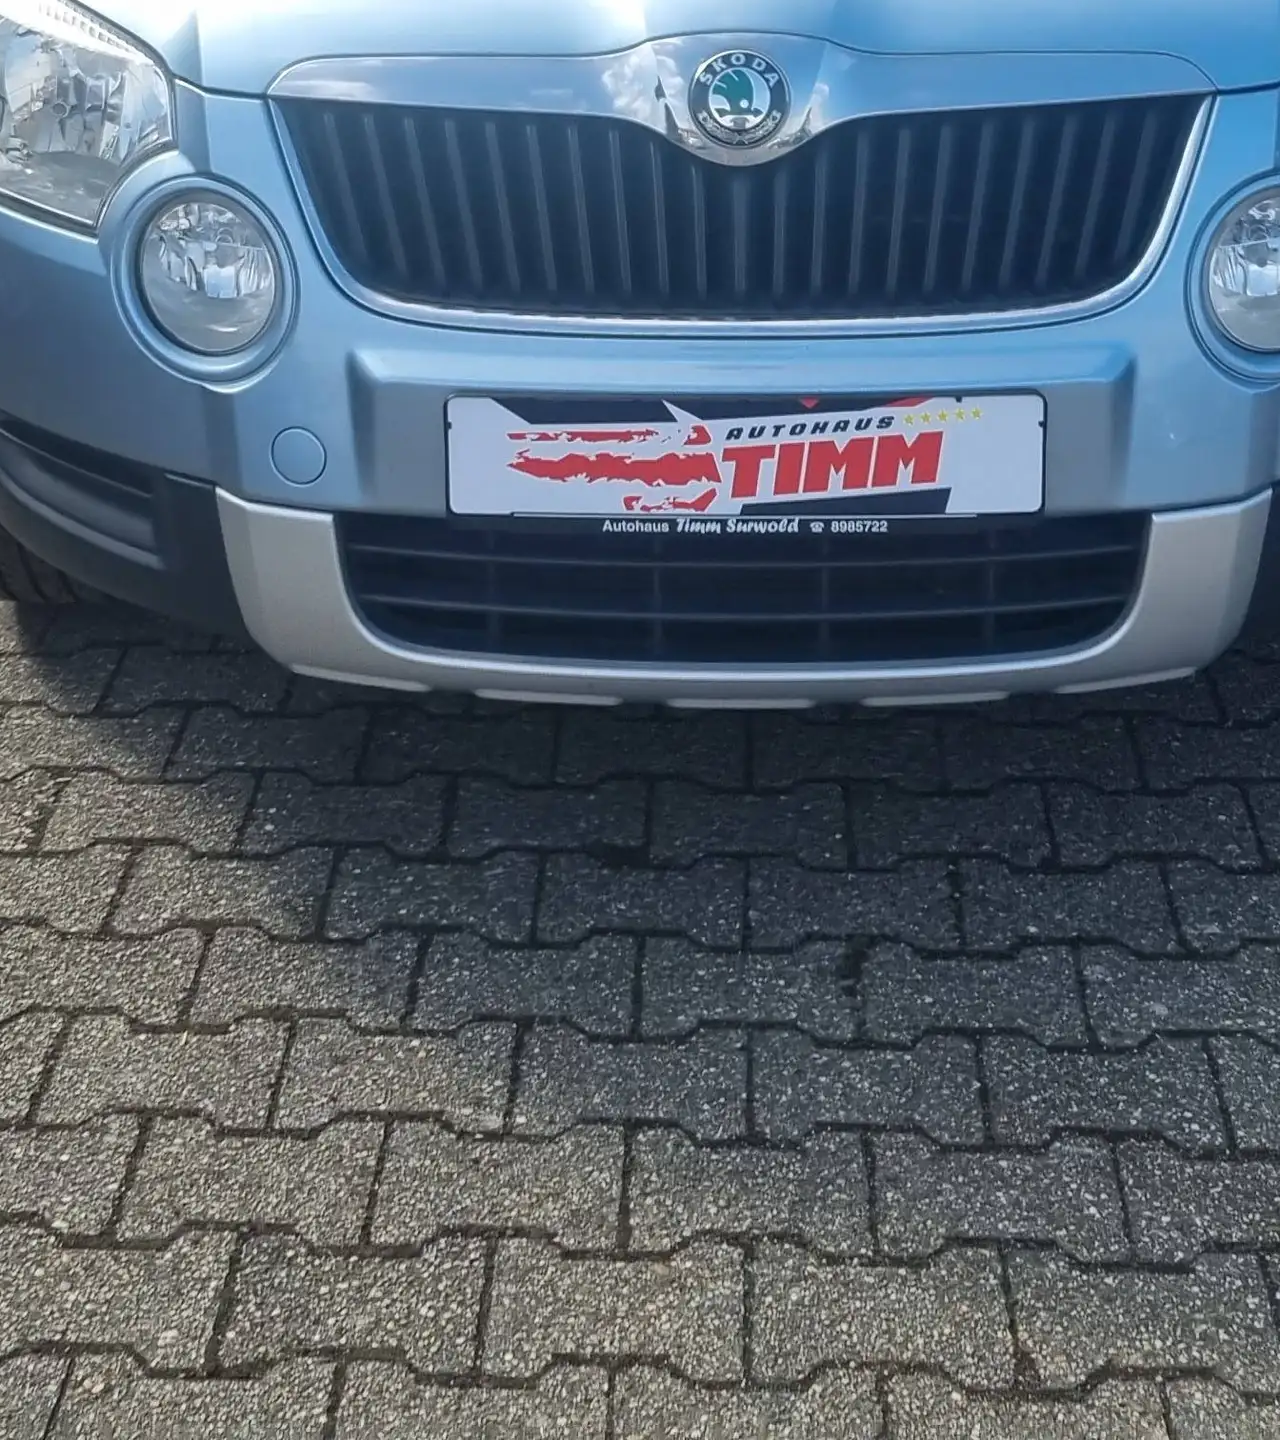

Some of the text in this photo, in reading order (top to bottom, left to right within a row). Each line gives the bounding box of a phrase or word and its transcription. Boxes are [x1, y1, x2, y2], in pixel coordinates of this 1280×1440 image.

[725, 415, 895, 441] AUTOHAUS
[721, 430, 944, 498] TIMM
[602, 519, 670, 533] Autohaus
[676, 517, 721, 535] Timm
[726, 517, 800, 533] Surwold
